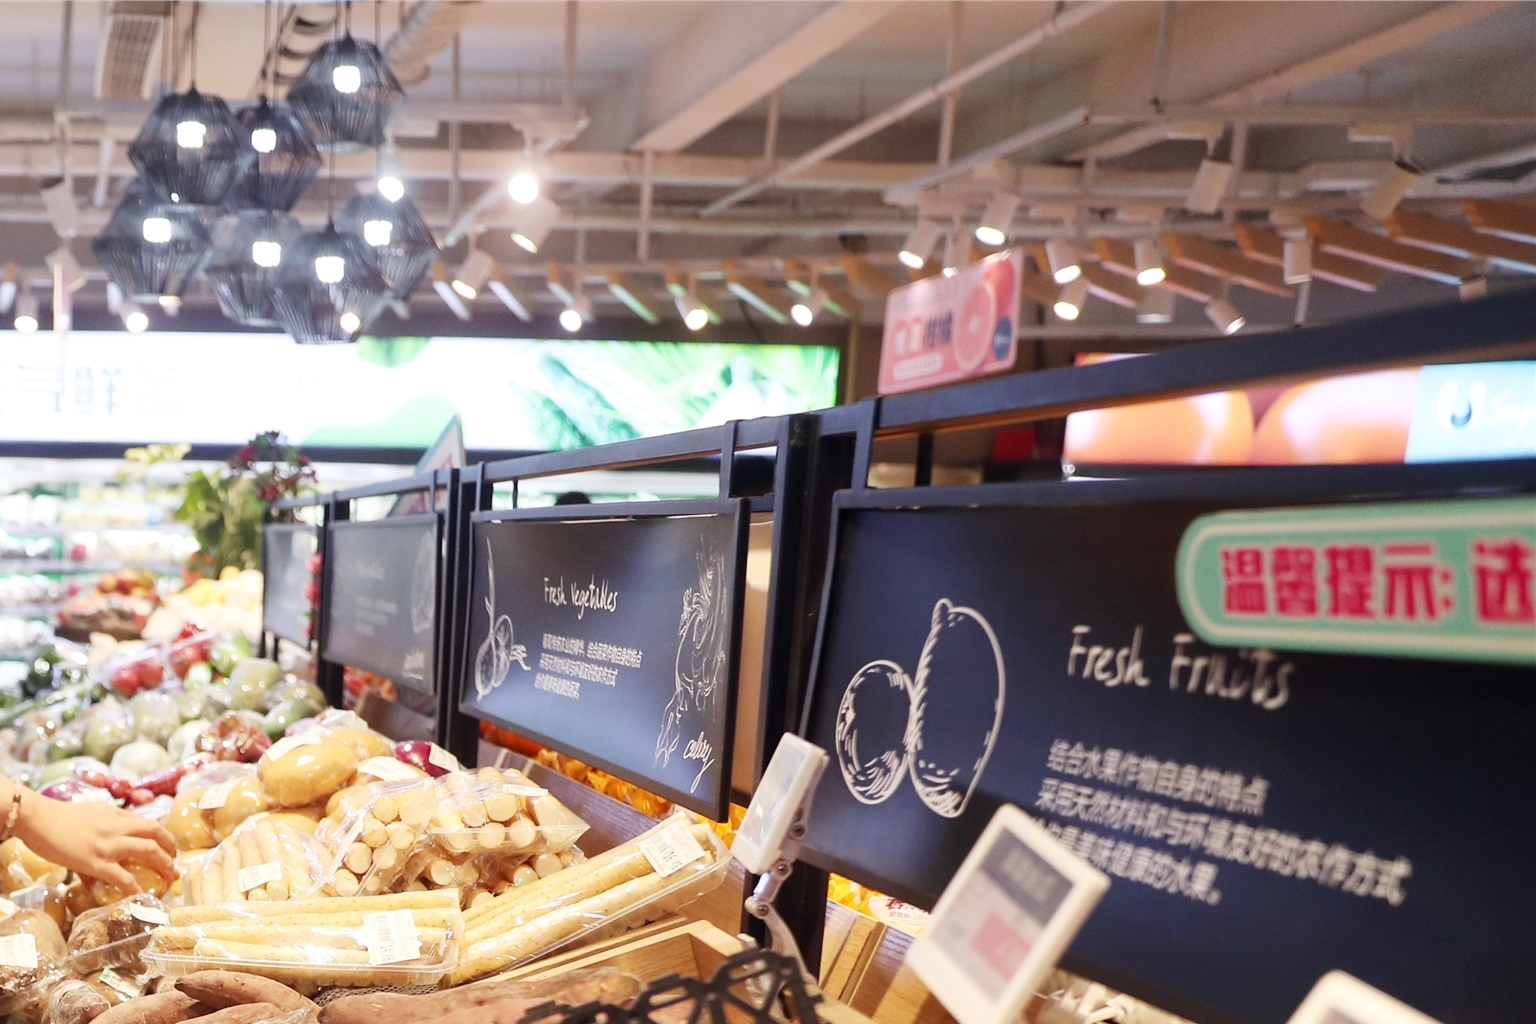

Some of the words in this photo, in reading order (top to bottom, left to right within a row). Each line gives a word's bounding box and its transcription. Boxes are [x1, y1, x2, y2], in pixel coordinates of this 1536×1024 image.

[543, 575, 567, 606] Fresh
[570, 573, 619, 620] Vegetables
[1067, 625, 1150, 688] Fresh
[1169, 633, 1295, 711] Fruits
